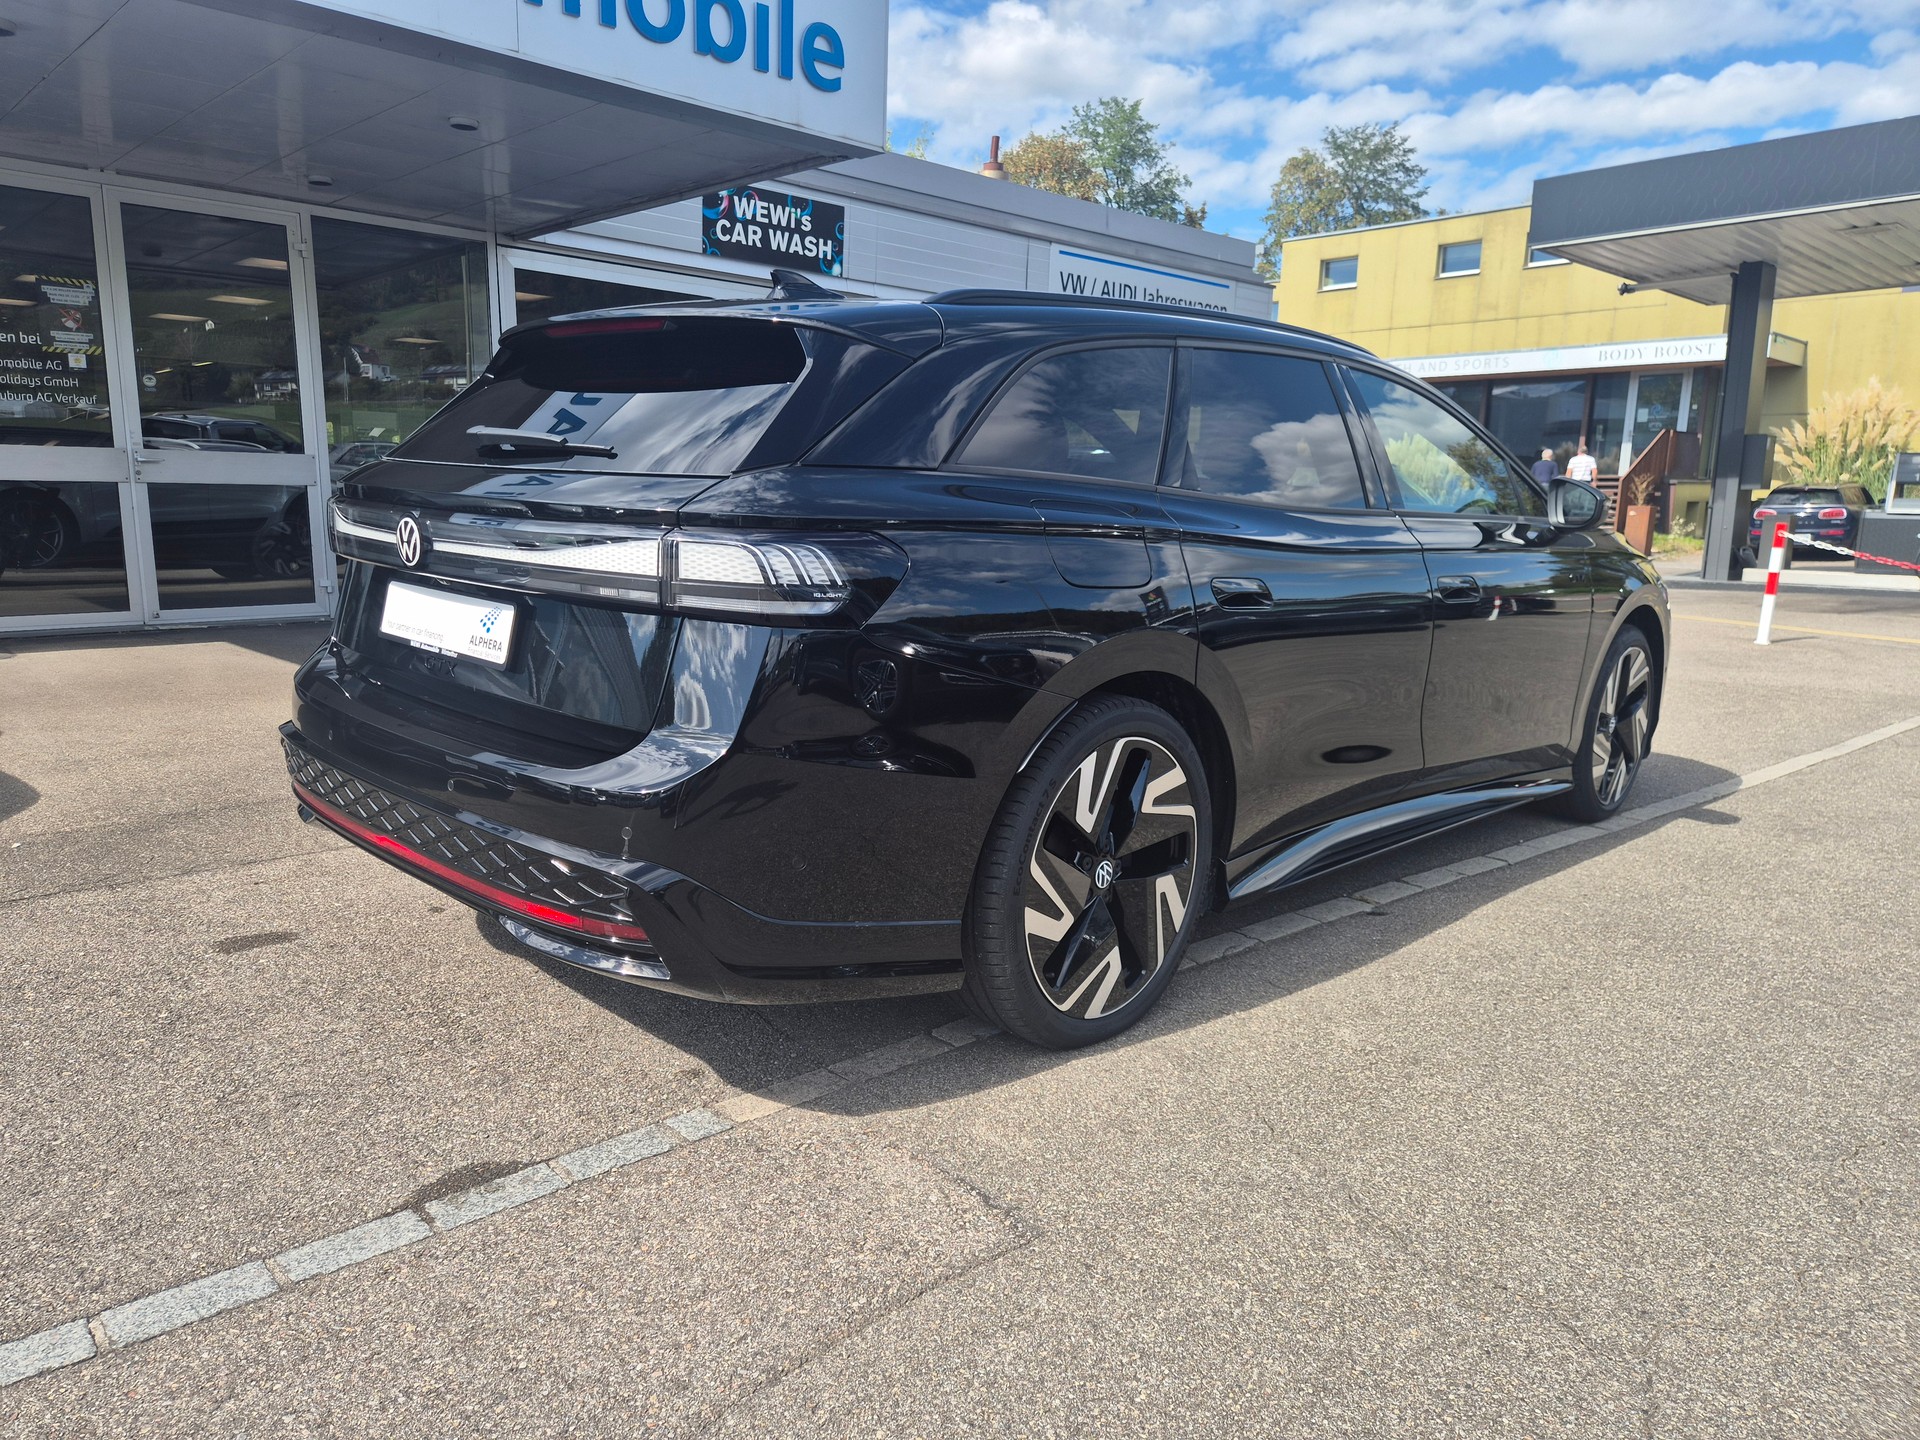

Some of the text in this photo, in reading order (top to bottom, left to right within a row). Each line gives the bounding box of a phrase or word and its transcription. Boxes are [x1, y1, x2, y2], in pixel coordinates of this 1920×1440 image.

[733, 195, 812, 231] WEWi's
[715, 217, 833, 260] CAR WASH
[1059, 271, 1087, 295] VW
[1090, 277, 1098, 296] /
[1101, 280, 1138, 301] AUDI
[19, 331, 42, 344] bei
[1598, 343, 1717, 362] BODY BOOST
[45, 360, 62, 370] AG
[1418, 361, 1448, 373] AND
[1454, 357, 1511, 371] SPORTS
[43, 376, 79, 387] GmbH
[36, 392, 53, 402] AG
[54, 393, 98, 405] Verkauf
[469, 634, 503, 653] ALPHERA
[424, 655, 458, 678] GTX
